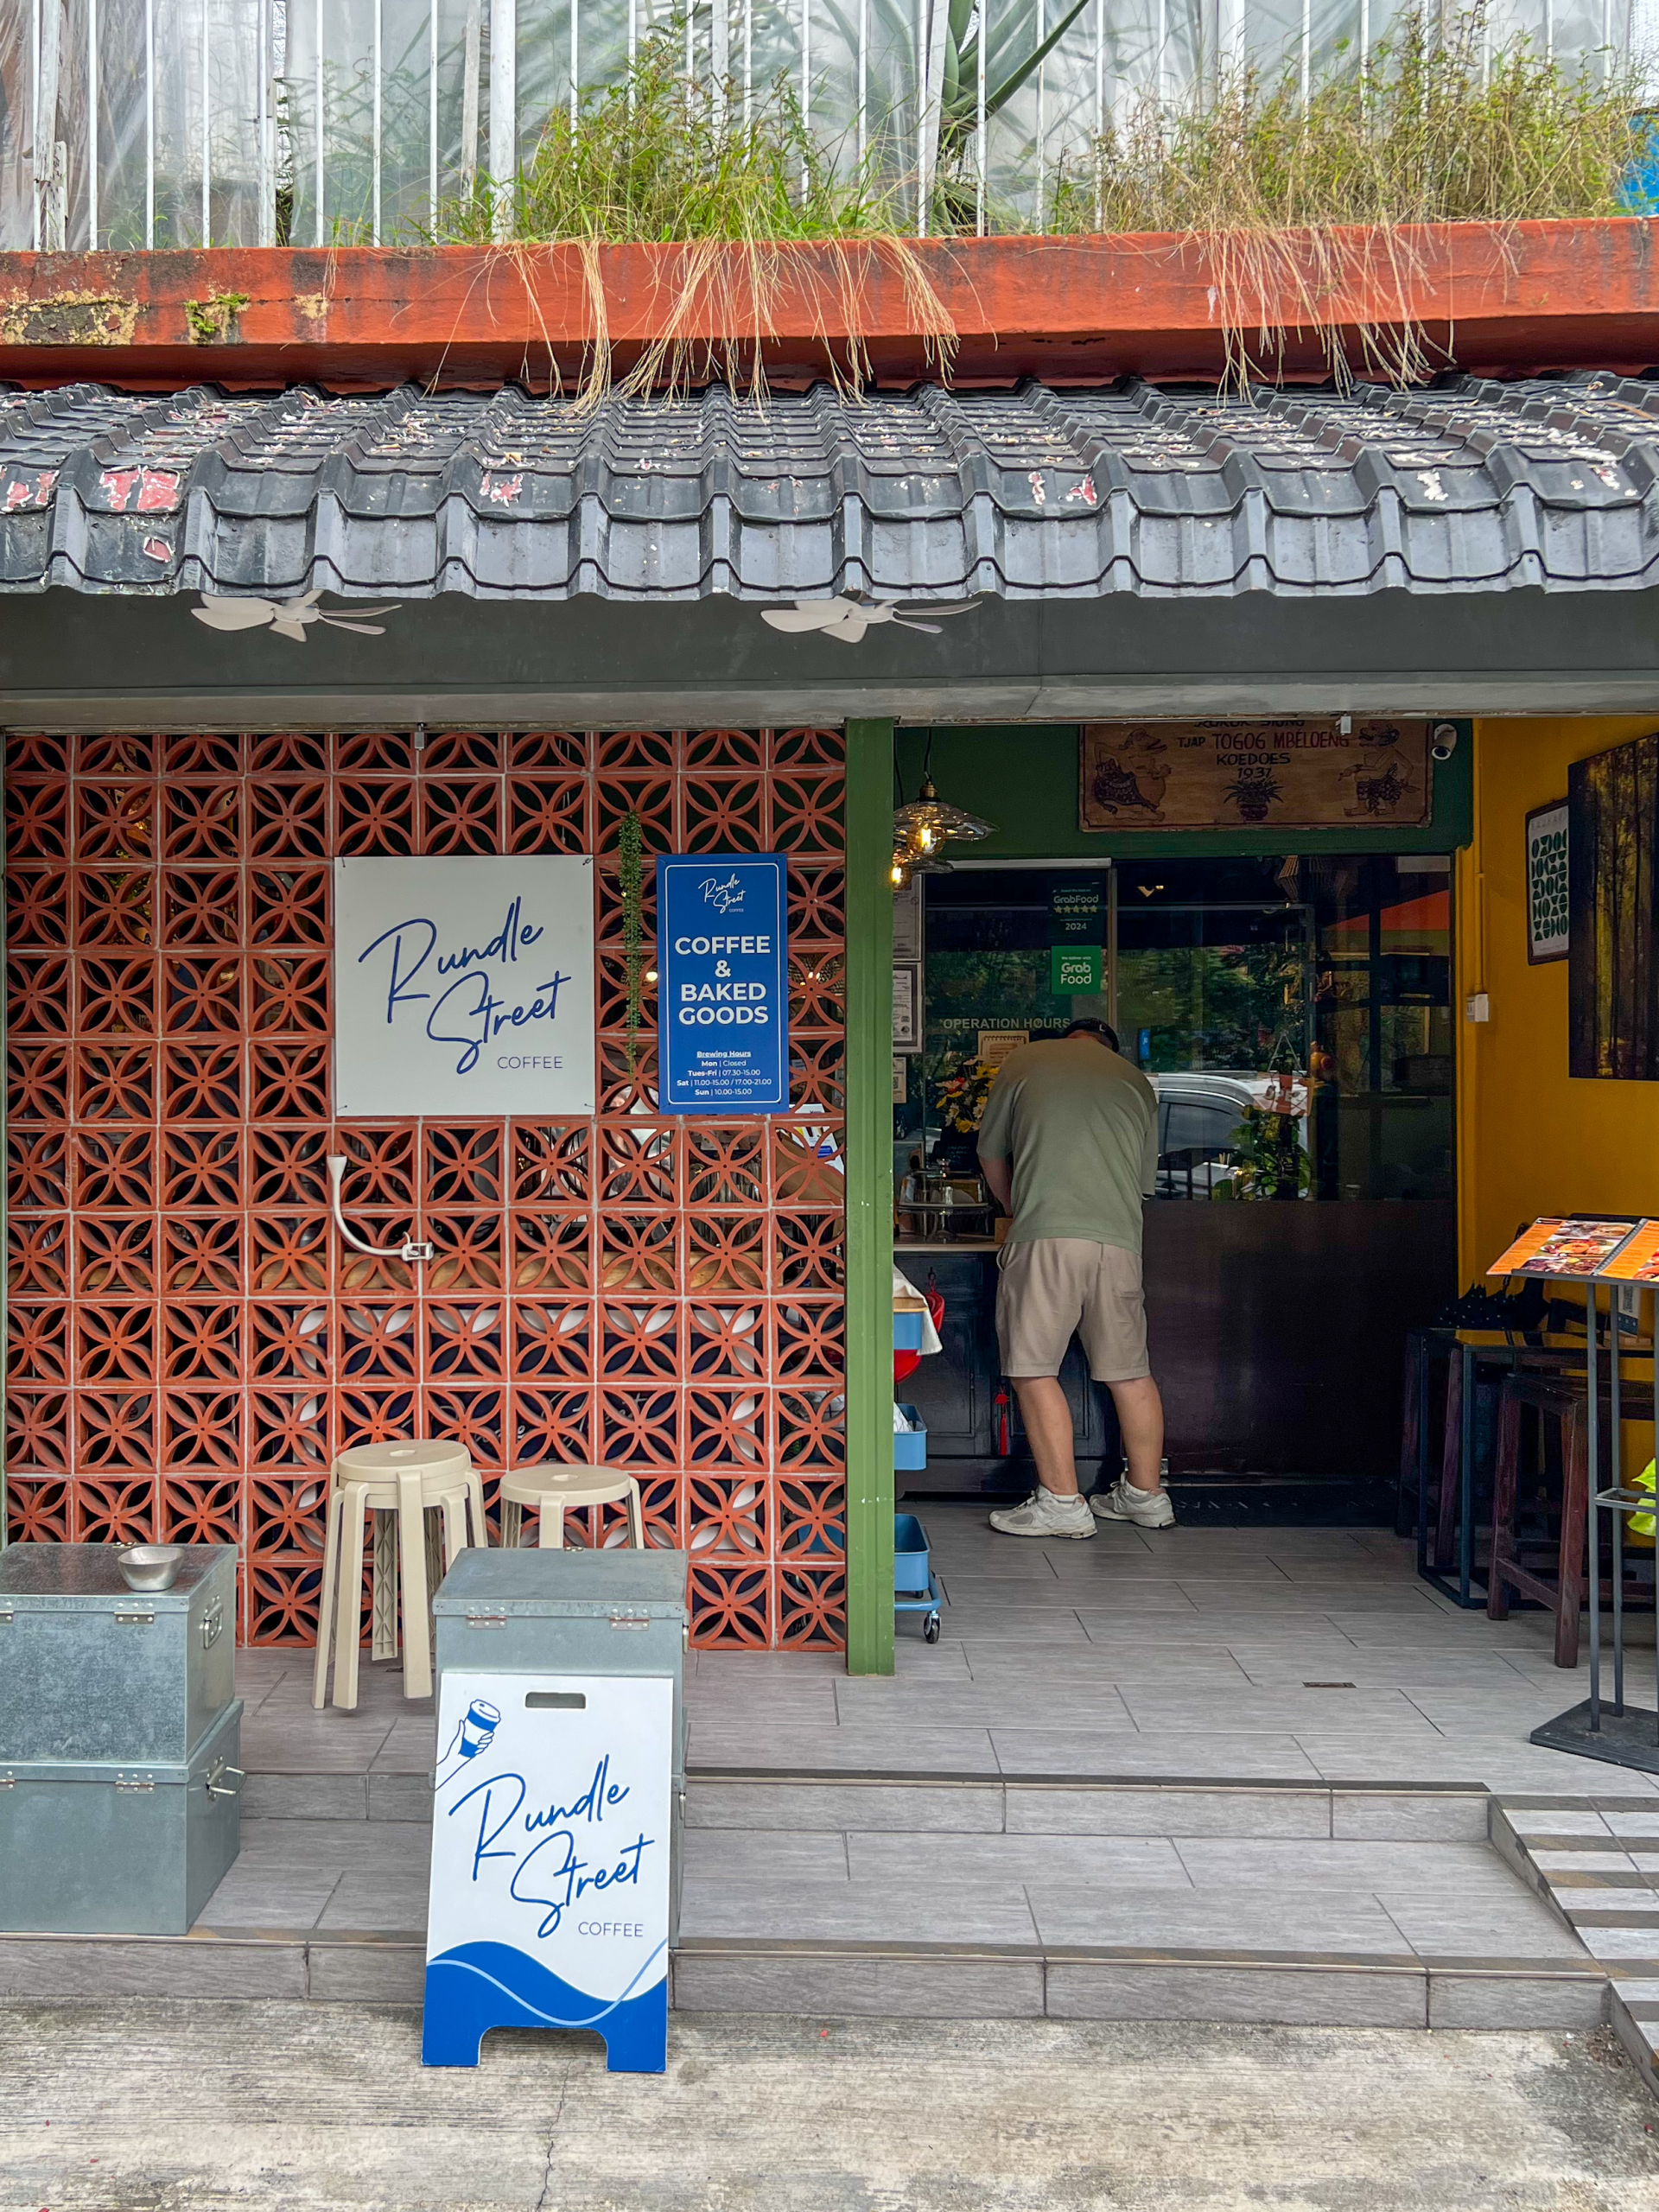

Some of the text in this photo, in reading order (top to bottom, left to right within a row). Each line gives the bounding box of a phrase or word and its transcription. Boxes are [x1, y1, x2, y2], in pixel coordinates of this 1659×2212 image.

[1177, 736, 1205, 748] TJAP
[1211, 732, 1266, 750] TOGOG
[1216, 752, 1291, 766] KOEDOES
[698, 873, 740, 903] Rundle
[713, 889, 747, 914] Street
[1053, 894, 1099, 904] GrabFood
[1065, 922, 1087, 931] 2024
[675, 936, 771, 955] COFFEE
[358, 895, 543, 1024] Rundle
[715, 959, 732, 978] &
[1061, 962, 1091, 973] Grab
[1060, 973, 1092, 984] Food
[681, 982, 766, 1001] BAKED
[426, 970, 572, 1075] Street
[678, 1006, 769, 1025] GOODS
[943, 1017, 1071, 1029] OPERATION HOURS
[497, 1056, 563, 1069] COFFEE
[448, 1753, 631, 1882] Rundle
[510, 1830, 656, 1939] Street
[578, 1921, 644, 1938] COFFEE
